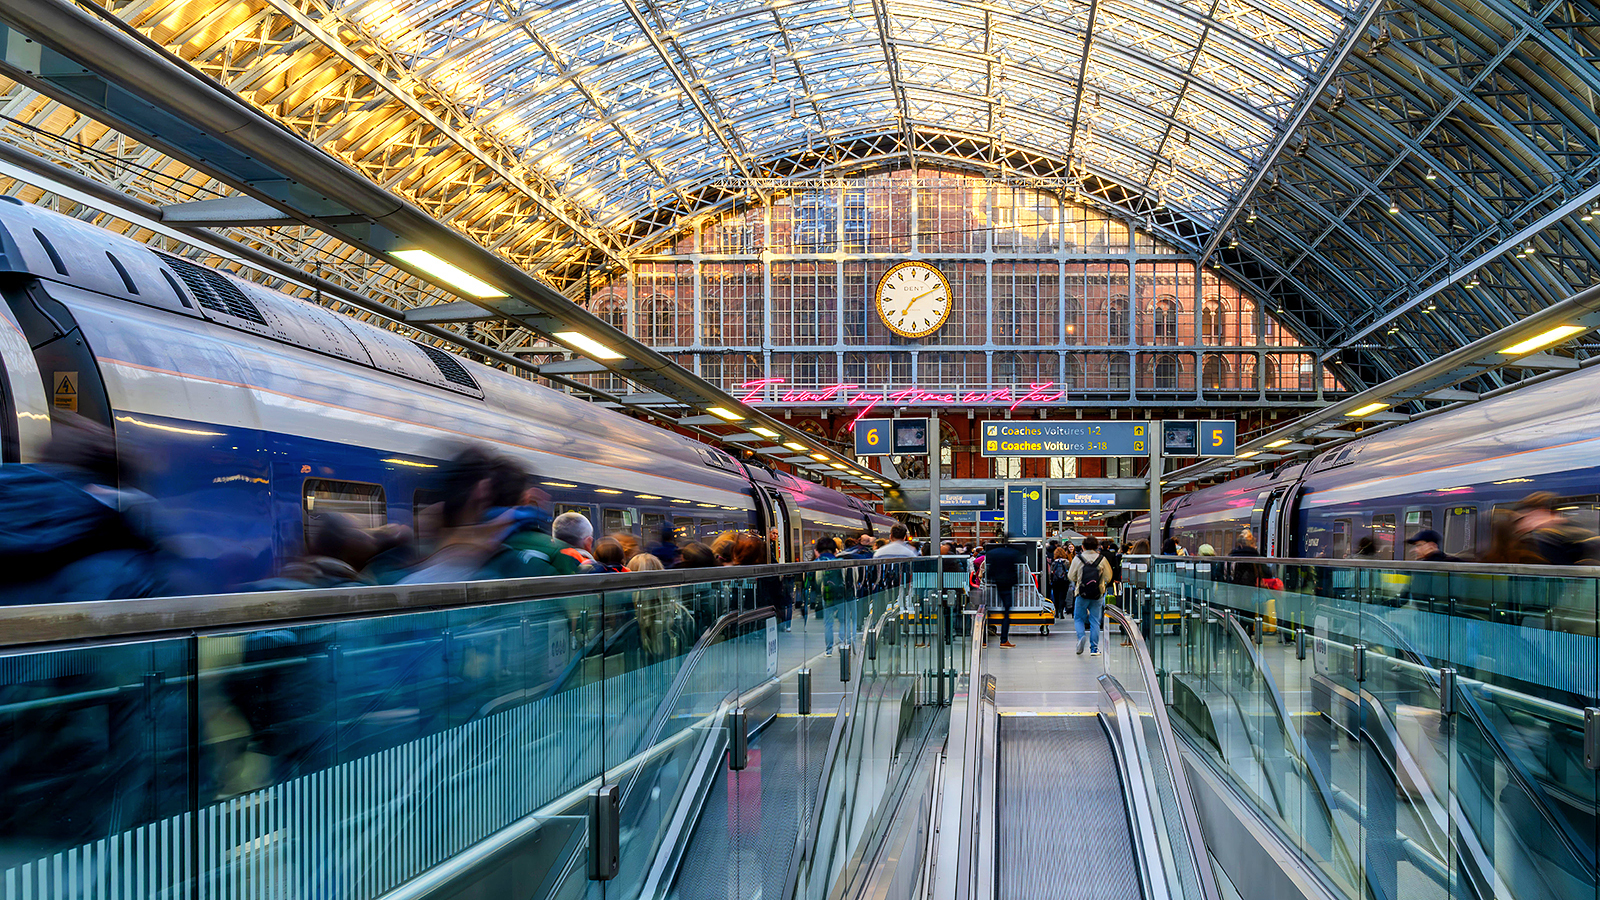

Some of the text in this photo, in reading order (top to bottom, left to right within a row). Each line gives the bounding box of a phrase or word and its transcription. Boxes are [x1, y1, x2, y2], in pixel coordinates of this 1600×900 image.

[741, 378, 785, 403] I
[866, 428, 879, 446] 6
[1001, 426, 1102, 436] Coaches Voitures 1-2
[1212, 429, 1224, 447] 5
[1001, 441, 1108, 451] Coaches Voitures 3-18
